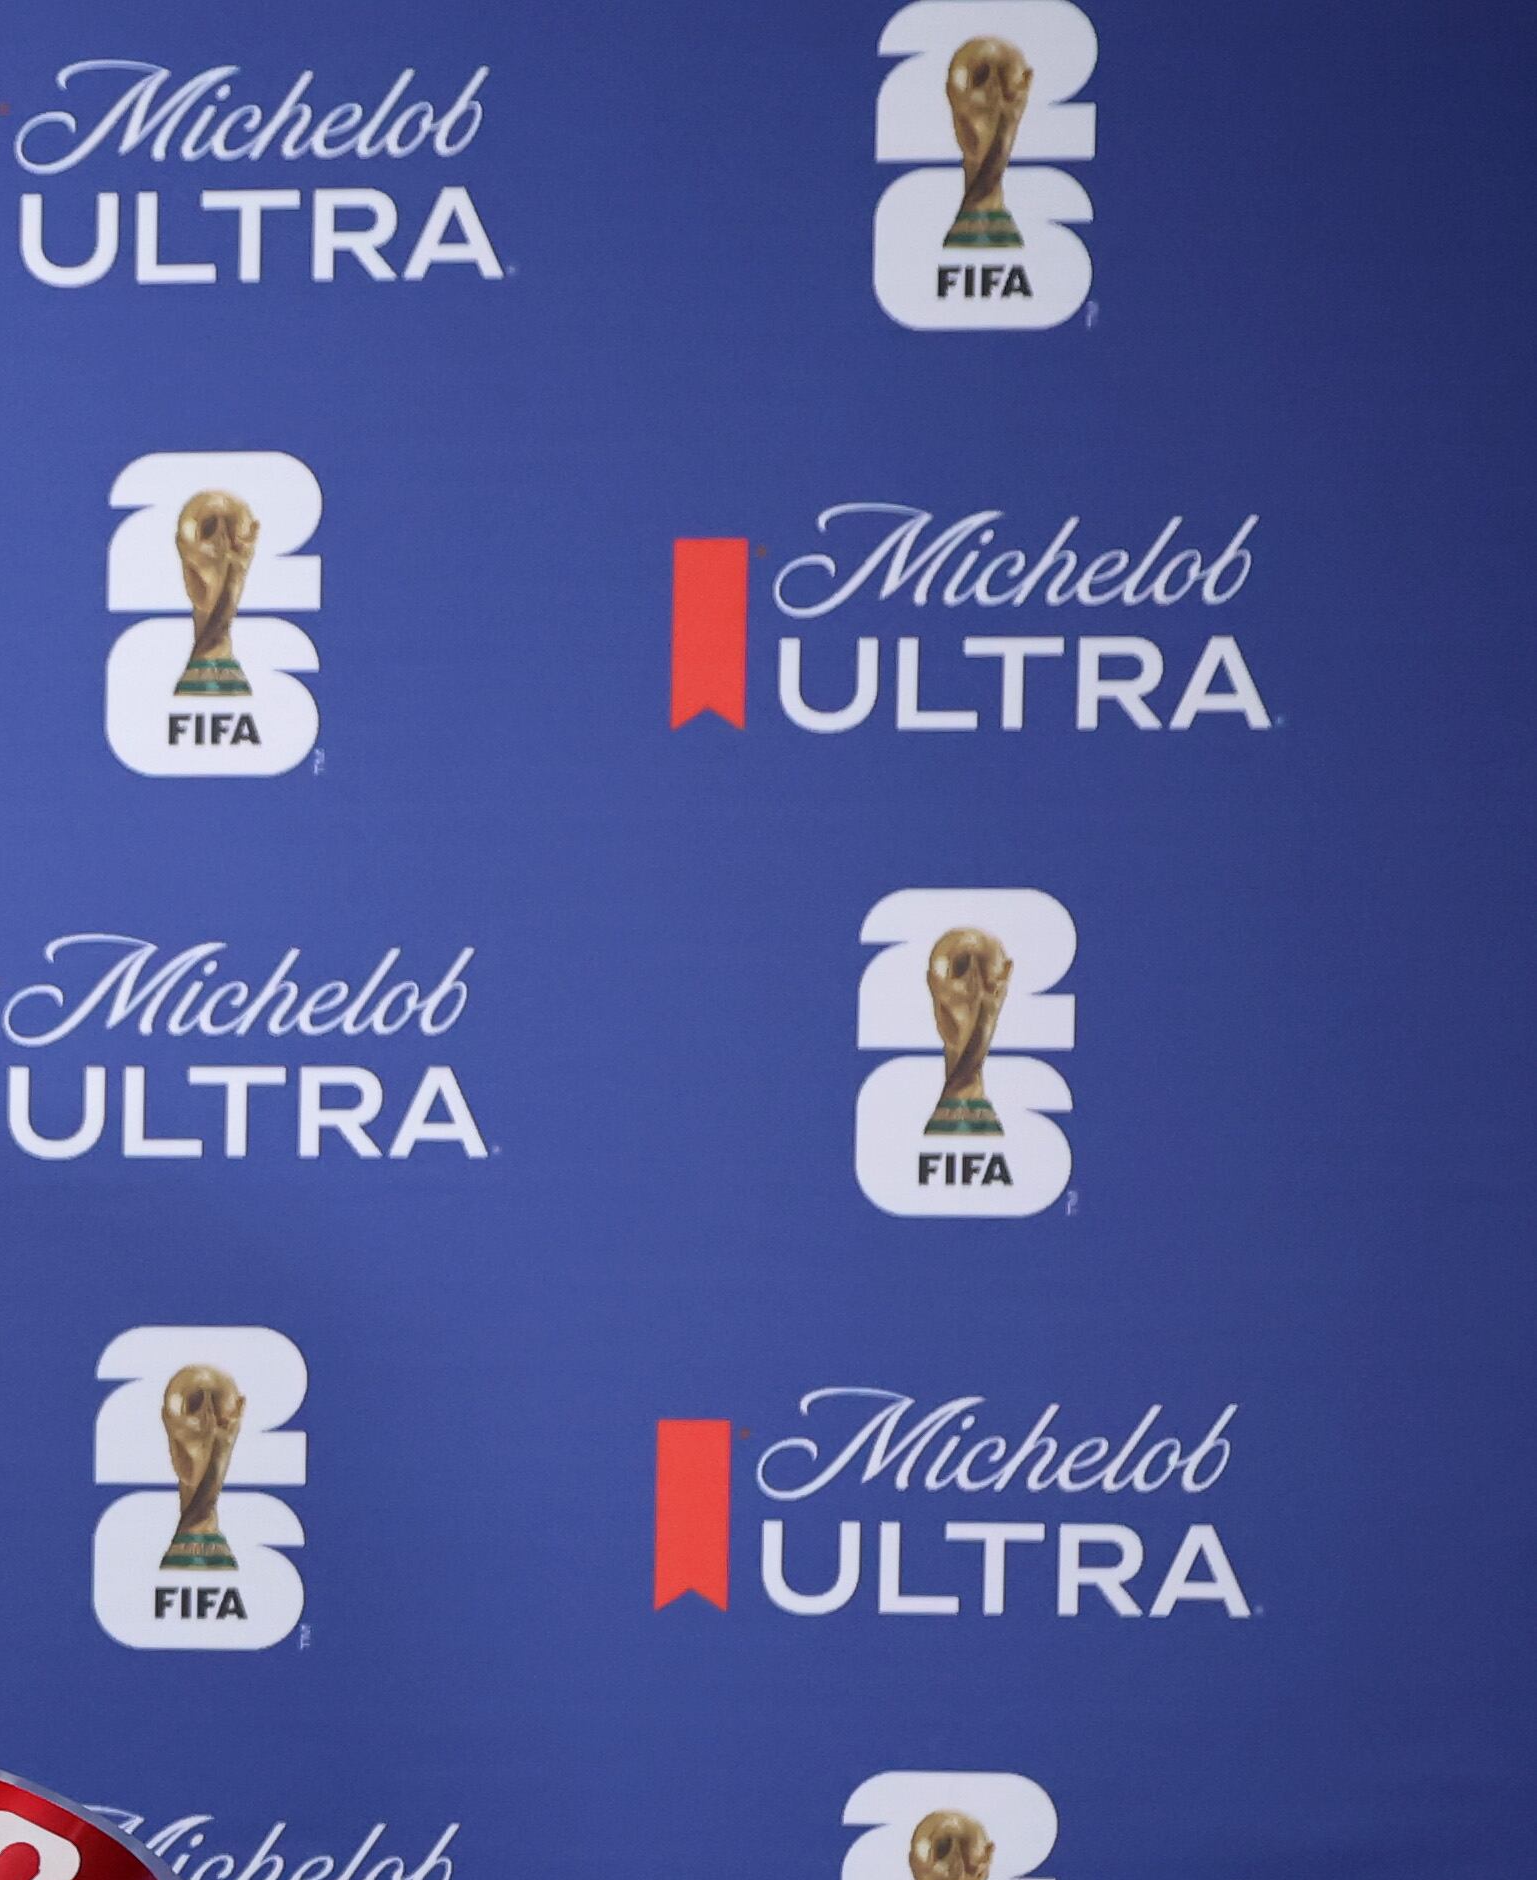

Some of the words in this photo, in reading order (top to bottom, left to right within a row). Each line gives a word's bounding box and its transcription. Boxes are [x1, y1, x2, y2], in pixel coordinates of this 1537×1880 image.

[14, 60, 488, 174] Michelob
[20, 187, 503, 288] ULTRA
[937, 265, 1032, 298] FIFA
[773, 503, 1259, 618] Michelob
[168, 713, 260, 745] FIFA
[779, 636, 1271, 734] ULTRA
[2, 934, 474, 1047] Michelob
[7, 1066, 488, 1159] ULTRA
[918, 1153, 1012, 1186] FIFA
[756, 1387, 1238, 1500] Michelob
[154, 1587, 247, 1620] FIFA
[761, 1520, 1250, 1618] ULTRA
